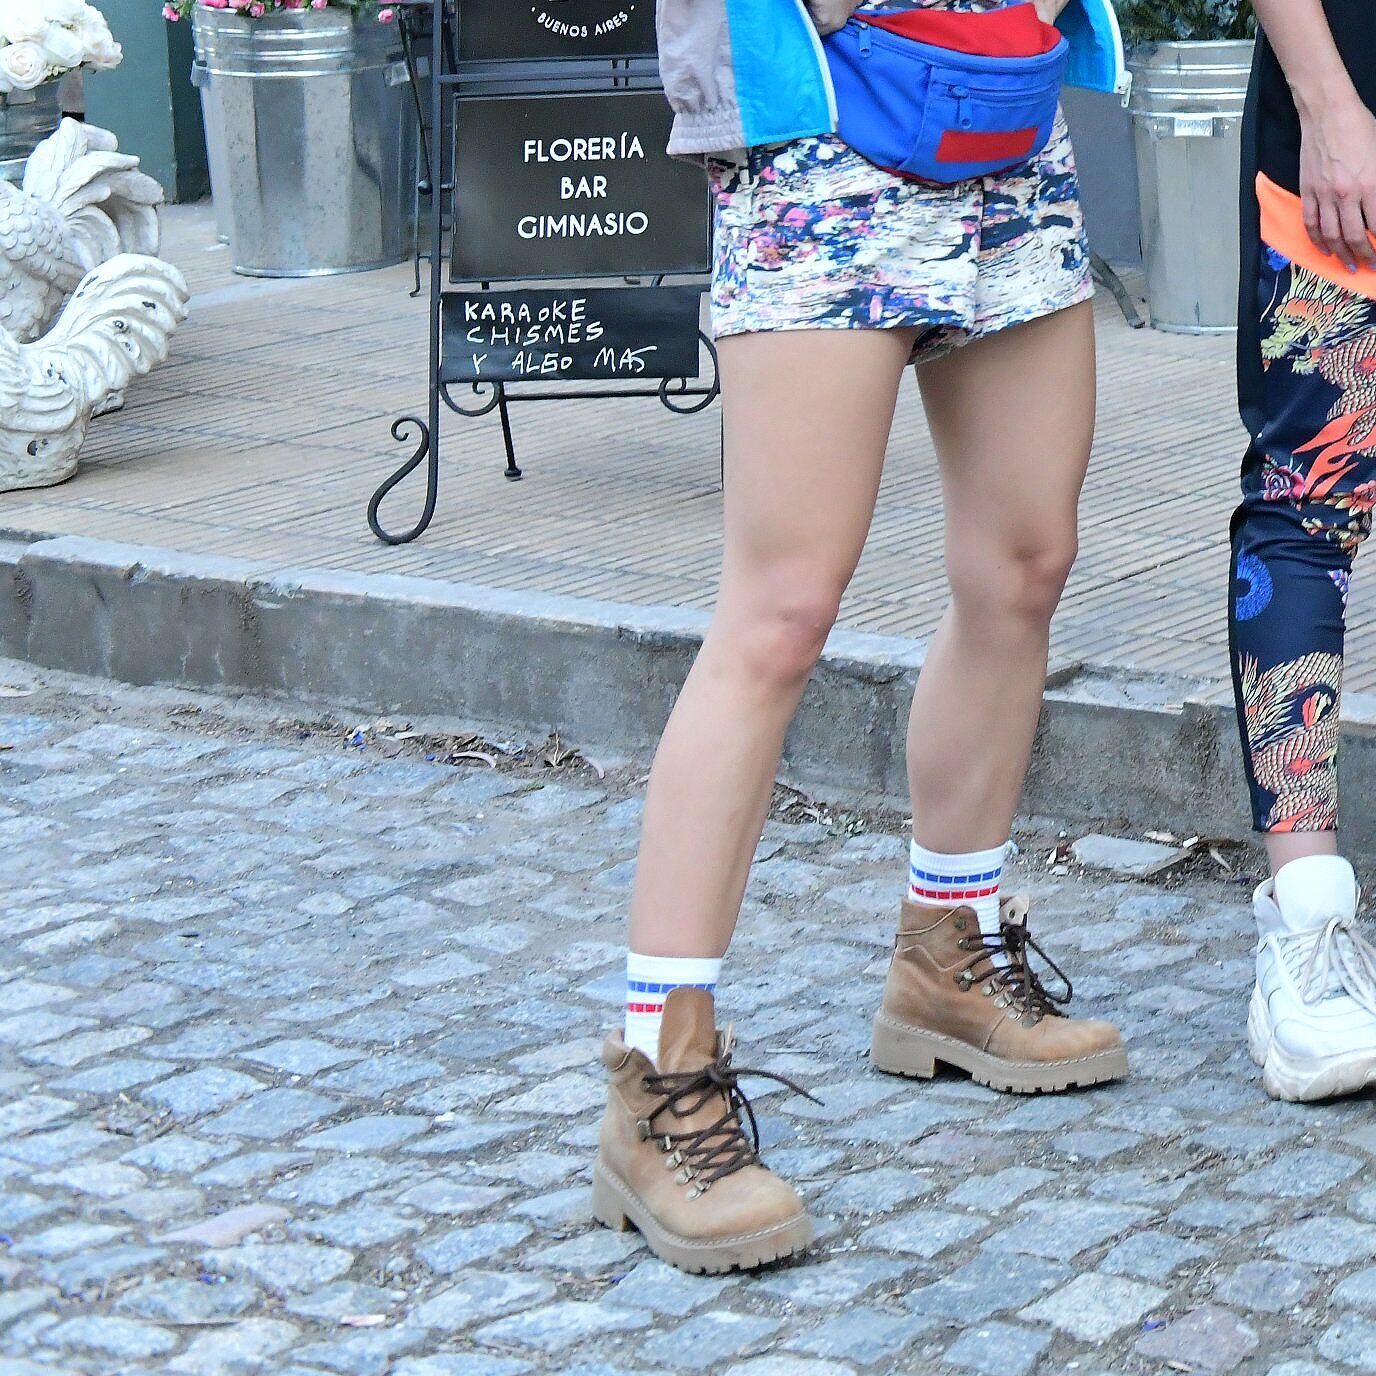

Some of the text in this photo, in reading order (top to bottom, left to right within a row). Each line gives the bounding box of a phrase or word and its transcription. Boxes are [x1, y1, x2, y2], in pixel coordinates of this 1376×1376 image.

[536, 10, 629, 38] BUENOS AIRES
[522, 131, 645, 163] FLORERÍA
[560, 175, 608, 200] BAR
[516, 211, 649, 239] GIMNASIO
[466, 321, 604, 346] CHISMES
[472, 353, 488, 375] Y
[593, 345, 658, 373] MAS
